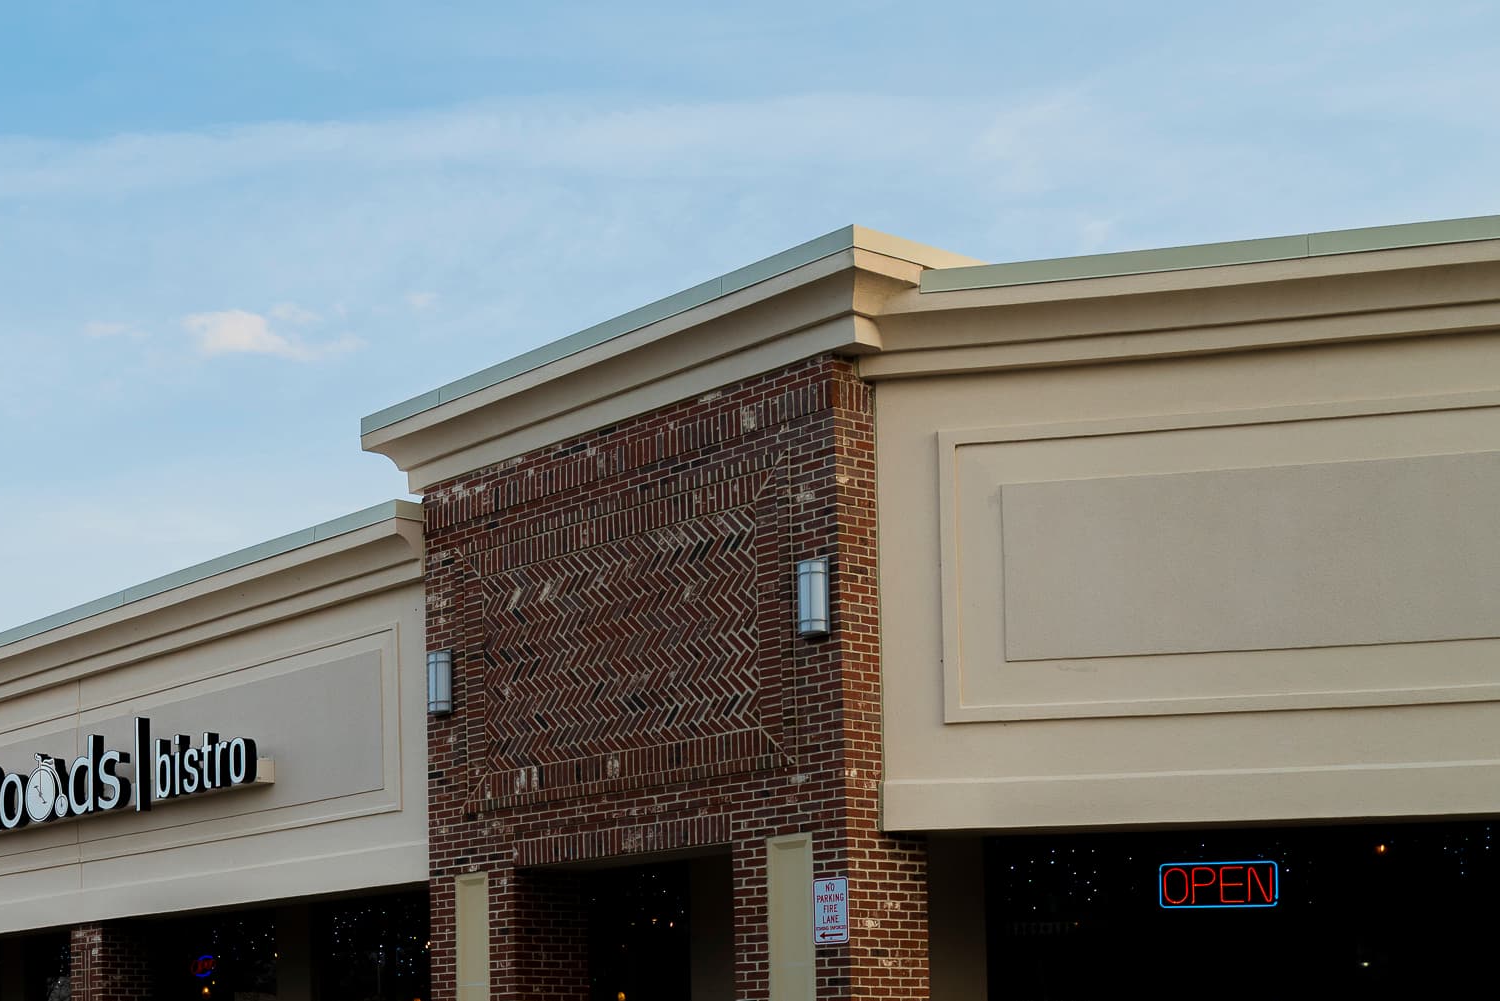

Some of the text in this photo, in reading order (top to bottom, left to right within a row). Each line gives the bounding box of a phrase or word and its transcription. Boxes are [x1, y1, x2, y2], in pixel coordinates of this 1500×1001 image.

[156, 732, 247, 799] bistro
[825, 883, 835, 892] NO
[1163, 866, 1272, 904] OPEN
[816, 893, 844, 903] PARKING
[823, 904, 838, 913] FIRE
[822, 915, 839, 924] LANE
